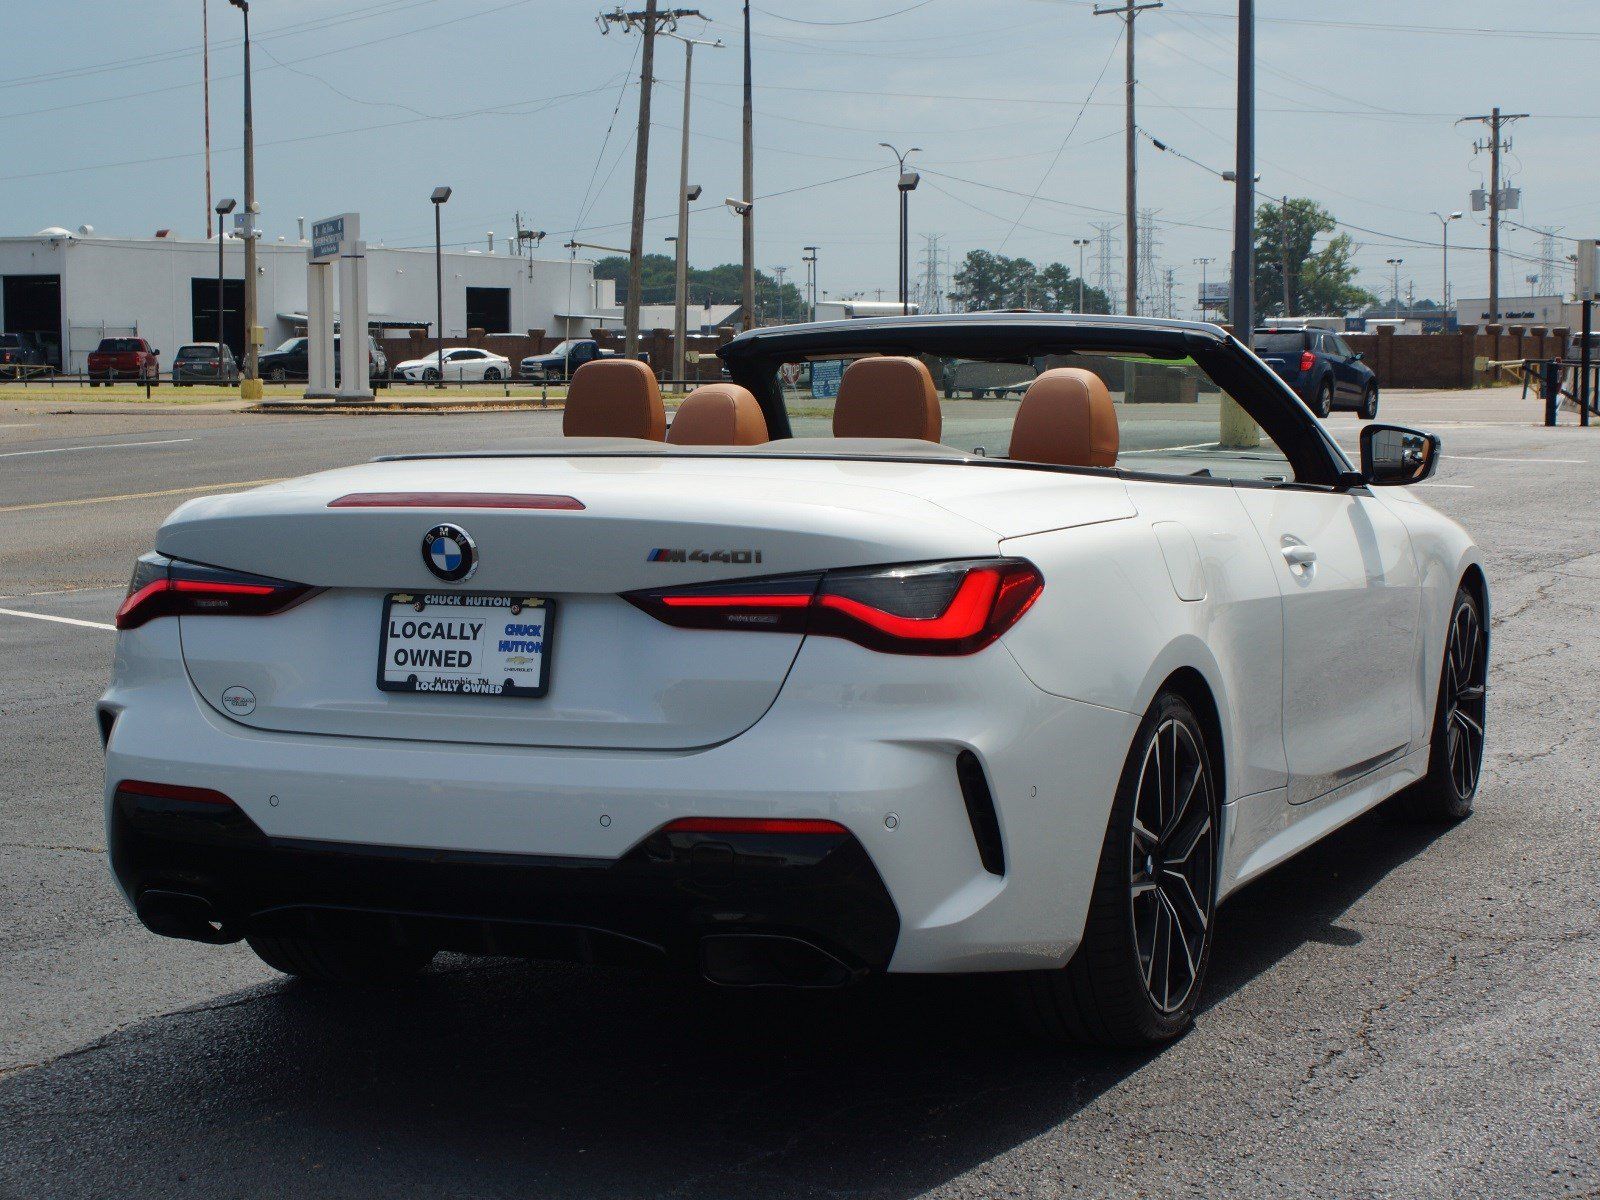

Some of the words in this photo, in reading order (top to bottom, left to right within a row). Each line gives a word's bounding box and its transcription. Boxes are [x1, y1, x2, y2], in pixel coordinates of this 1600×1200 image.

[425, 527, 467, 545] BMW
[656, 548, 762, 563] M440i
[424, 594, 461, 606] CHUCK
[465, 595, 511, 607] HUTTON
[389, 621, 483, 641] LOCALLY
[504, 624, 542, 637] CHUCK
[498, 640, 544, 653] HUTTON
[393, 648, 473, 668] OWNED
[415, 681, 459, 692] LOCALLY
[462, 683, 503, 695] OWNED
[478, 678, 490, 686] TN
